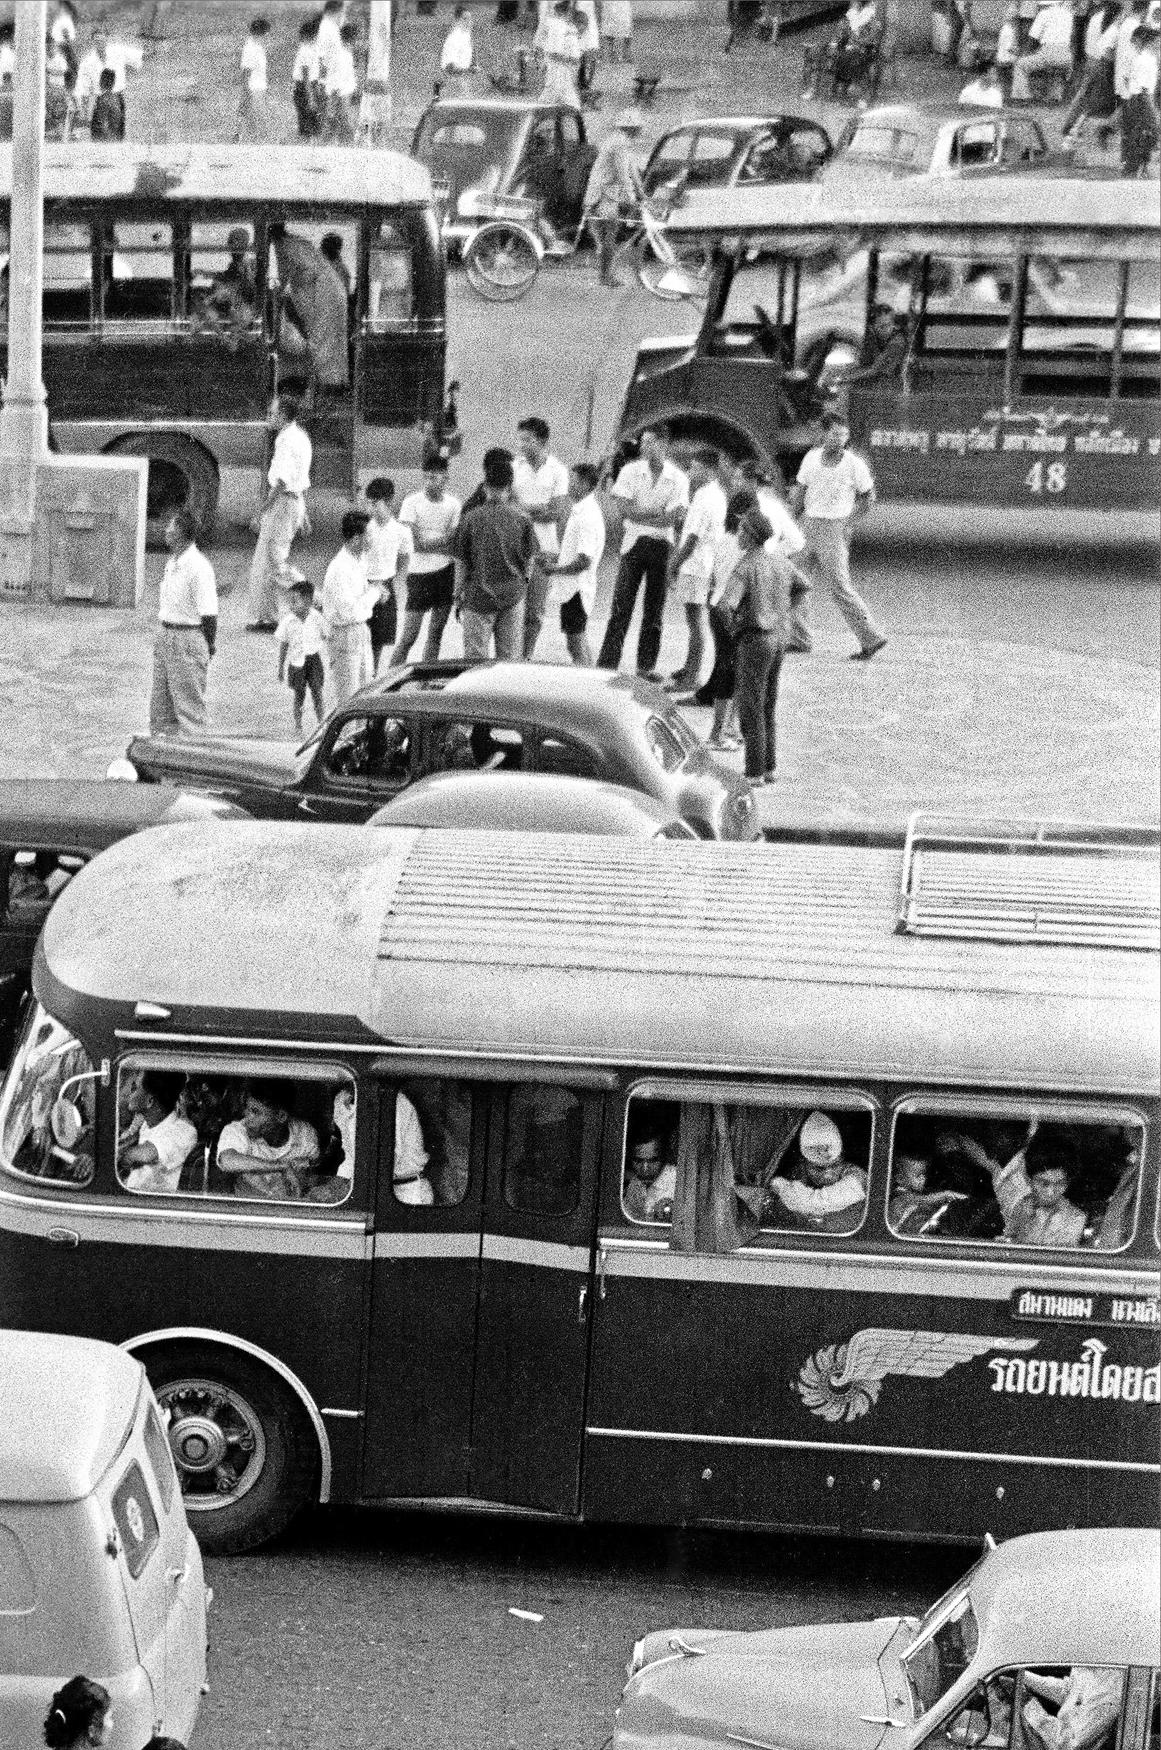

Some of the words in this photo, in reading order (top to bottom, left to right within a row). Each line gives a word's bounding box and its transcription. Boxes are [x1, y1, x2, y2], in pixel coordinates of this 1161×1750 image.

[1026, 461, 1066, 492] 48
[988, 1338, 1160, 1402] รถยนต์โดยส
